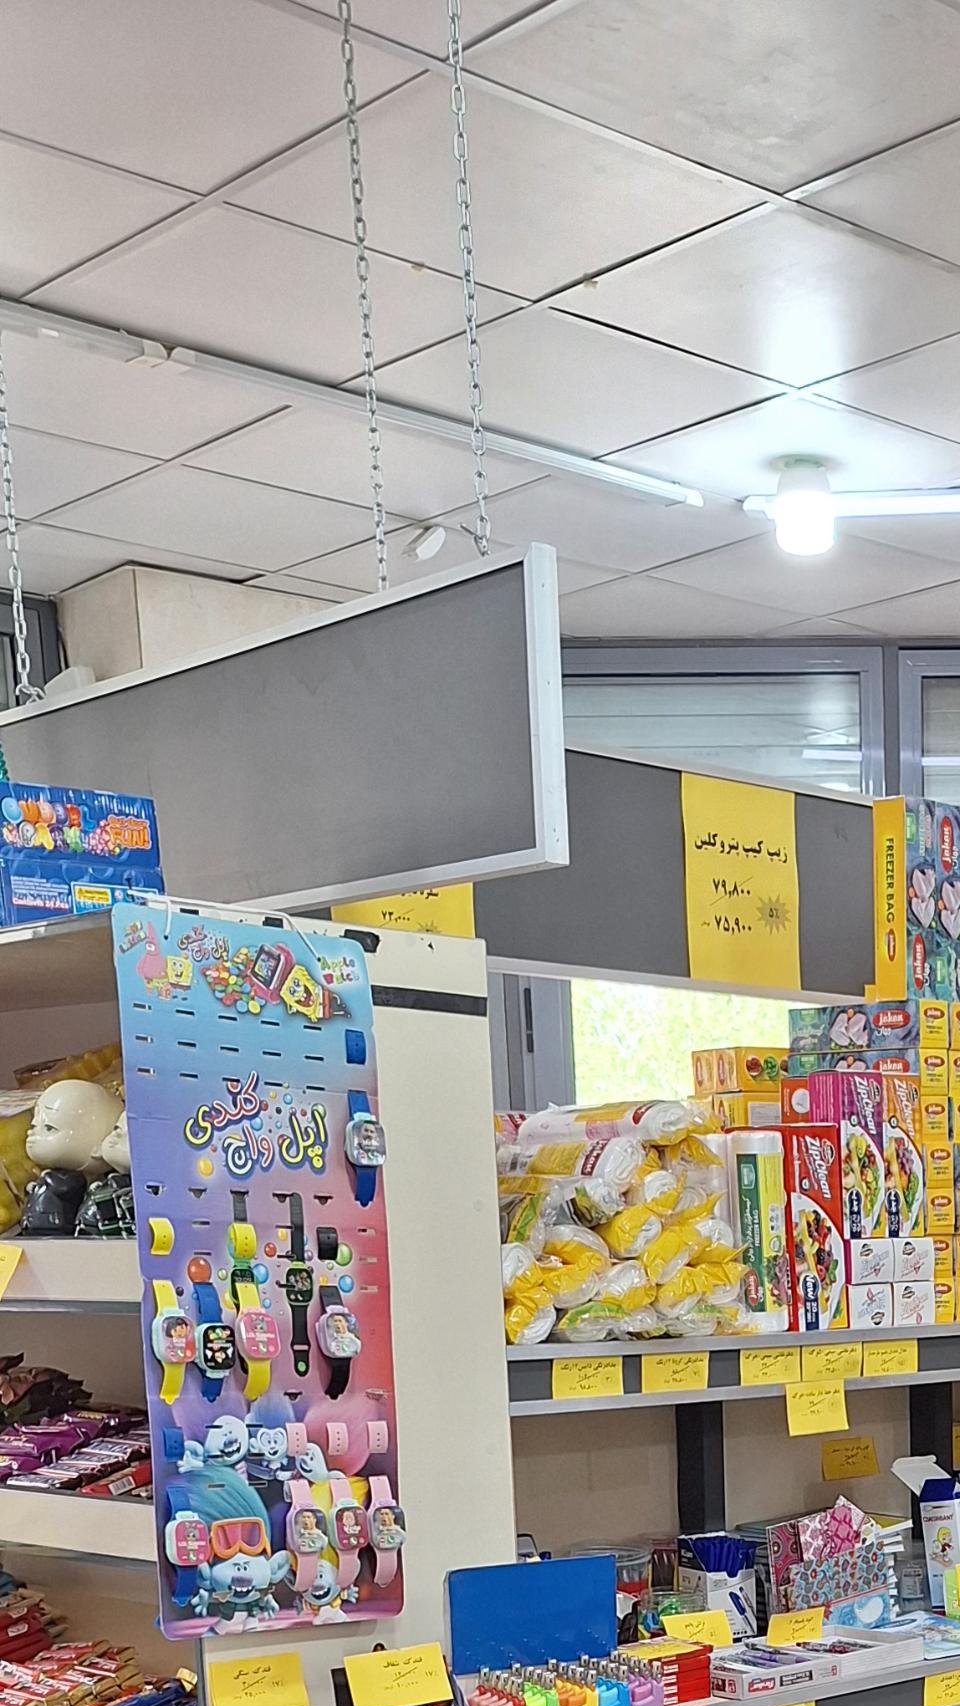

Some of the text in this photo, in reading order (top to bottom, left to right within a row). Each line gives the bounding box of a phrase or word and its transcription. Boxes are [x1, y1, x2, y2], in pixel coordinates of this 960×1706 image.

[111, 826, 148, 847] FUN!
[886, 837, 895, 924] FREEZER BAG
[185, 1072, 260, 1147] کندی
[223, 1108, 326, 1176] اپل واچ
[805, 1136, 833, 1200] ZipClean
